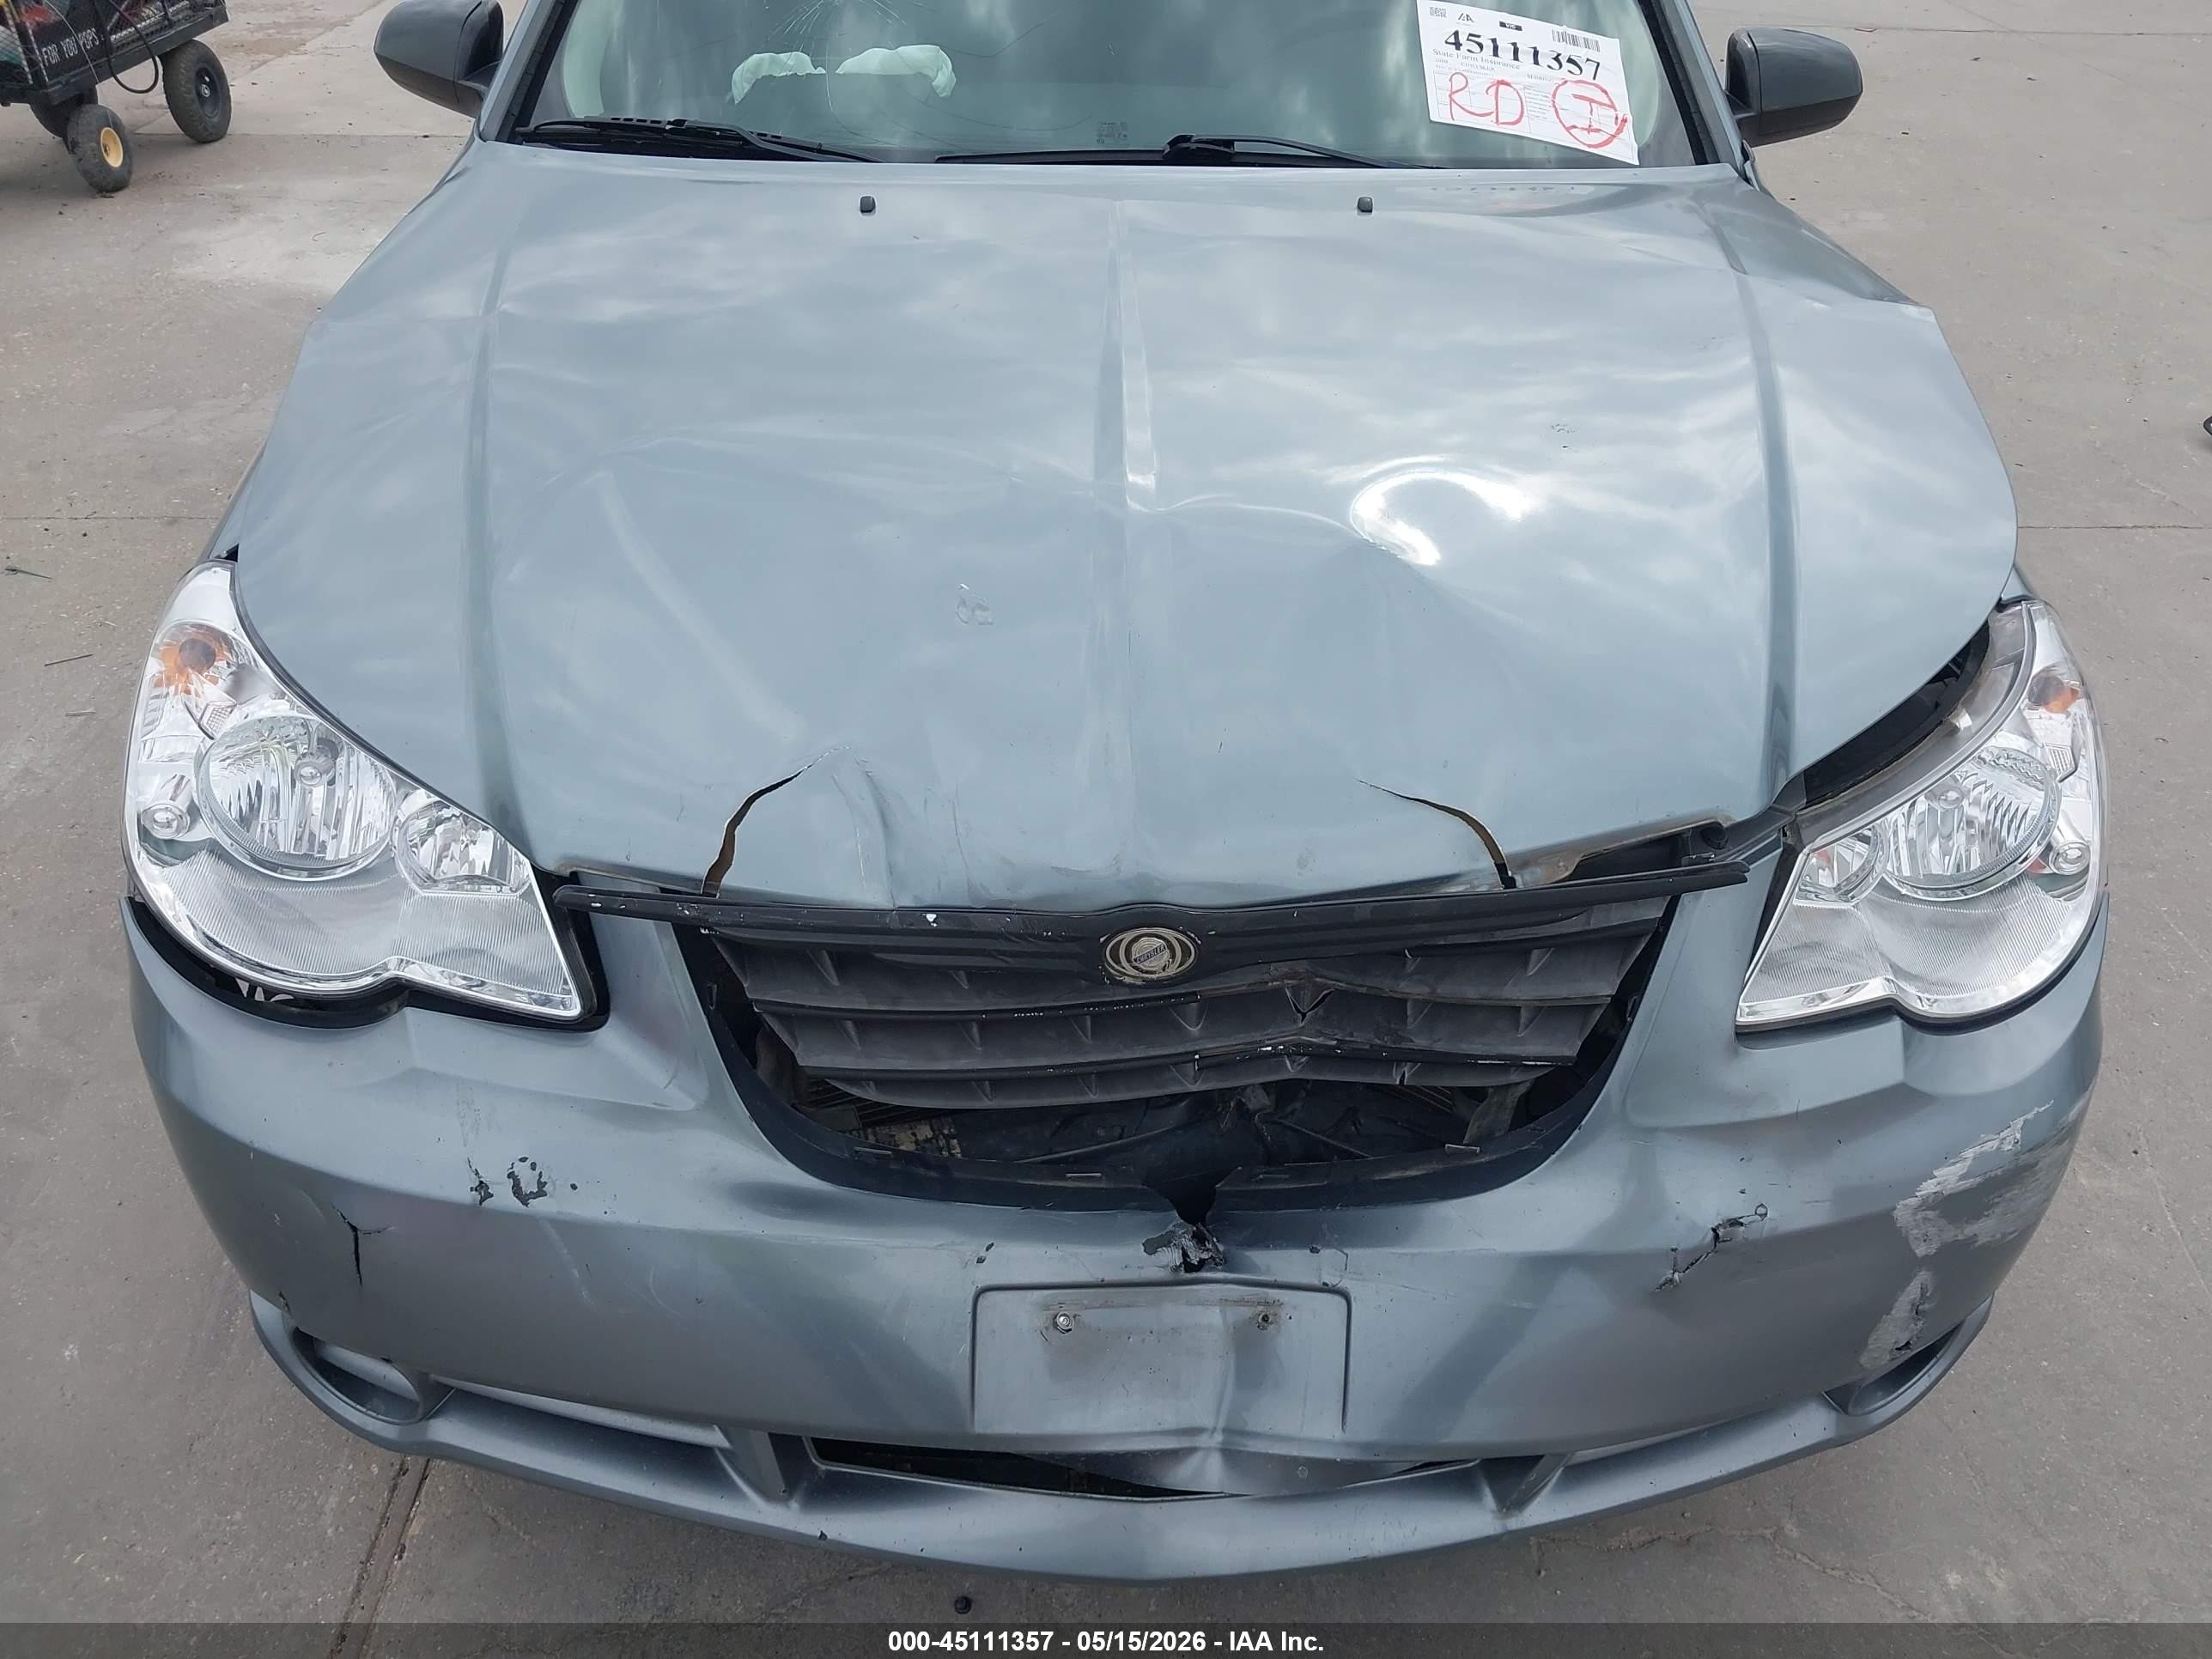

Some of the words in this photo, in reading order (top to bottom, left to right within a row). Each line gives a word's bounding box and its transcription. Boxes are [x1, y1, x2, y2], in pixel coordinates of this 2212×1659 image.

[41, 44, 61, 66] FOR
[60, 36, 79, 58] YOU
[1432, 48, 1454, 58] State
[1455, 53, 1479, 63] Farm
[1480, 57, 1521, 70] Insurance
[1444, 29, 1601, 80] 45111357
[1134, 944, 1166, 963] CHRYSLER
